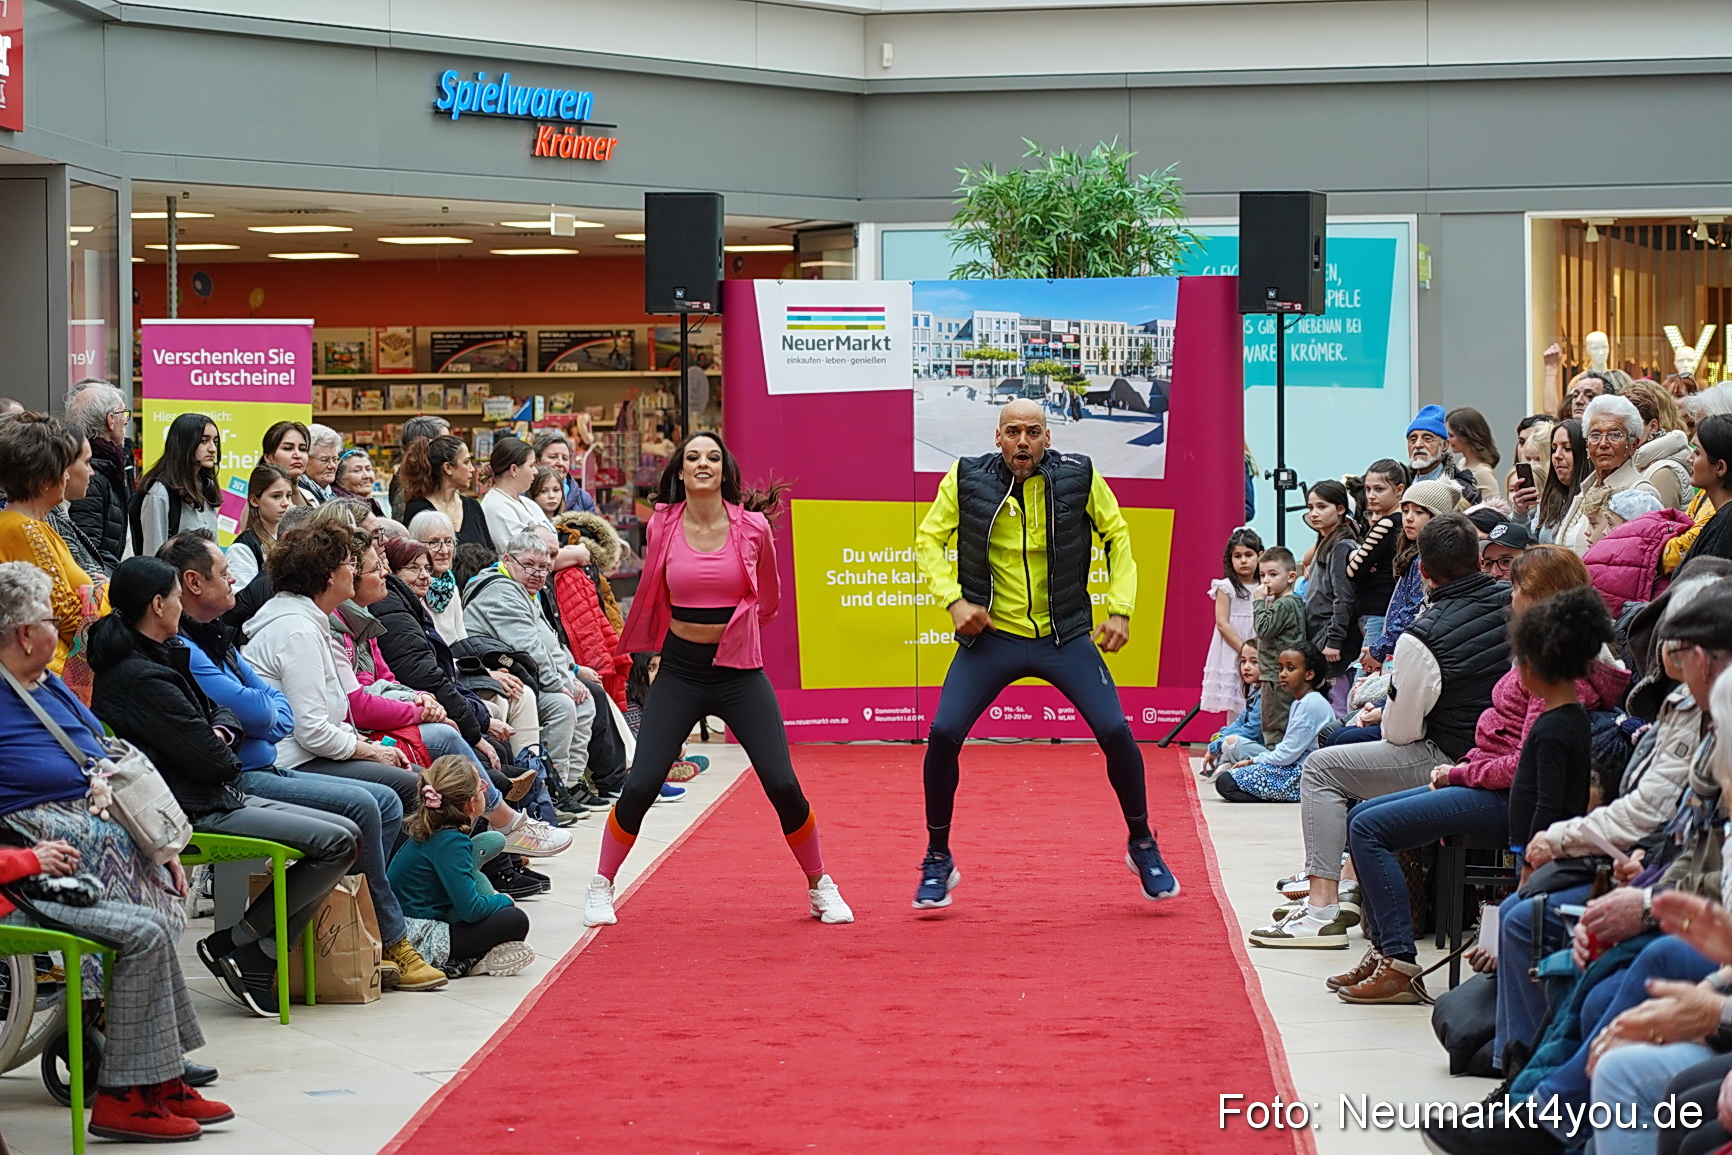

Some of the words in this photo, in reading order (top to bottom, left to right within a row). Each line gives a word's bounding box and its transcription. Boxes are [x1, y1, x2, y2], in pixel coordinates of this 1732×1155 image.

[436, 69, 594, 120] Spielwaren
[534, 125, 618, 161] Krömer
[1298, 319, 1342, 334] NEBENAN
[1347, 318, 1362, 334] BEI
[782, 334, 892, 351] NeuerMarkt
[1291, 339, 1348, 362] KRÖMER.
[152, 349, 265, 366] Verschenken
[268, 349, 295, 365] Sie
[786, 356, 822, 365] einkaufen
[850, 356, 887, 367] genießen
[190, 369, 296, 386] Gutscheine!
[842, 548, 865, 563] Du
[826, 569, 888, 586] Schuhe
[841, 591, 873, 607] und
[876, 590, 936, 606] deinen
[1057, 707, 1075, 715] gratis
